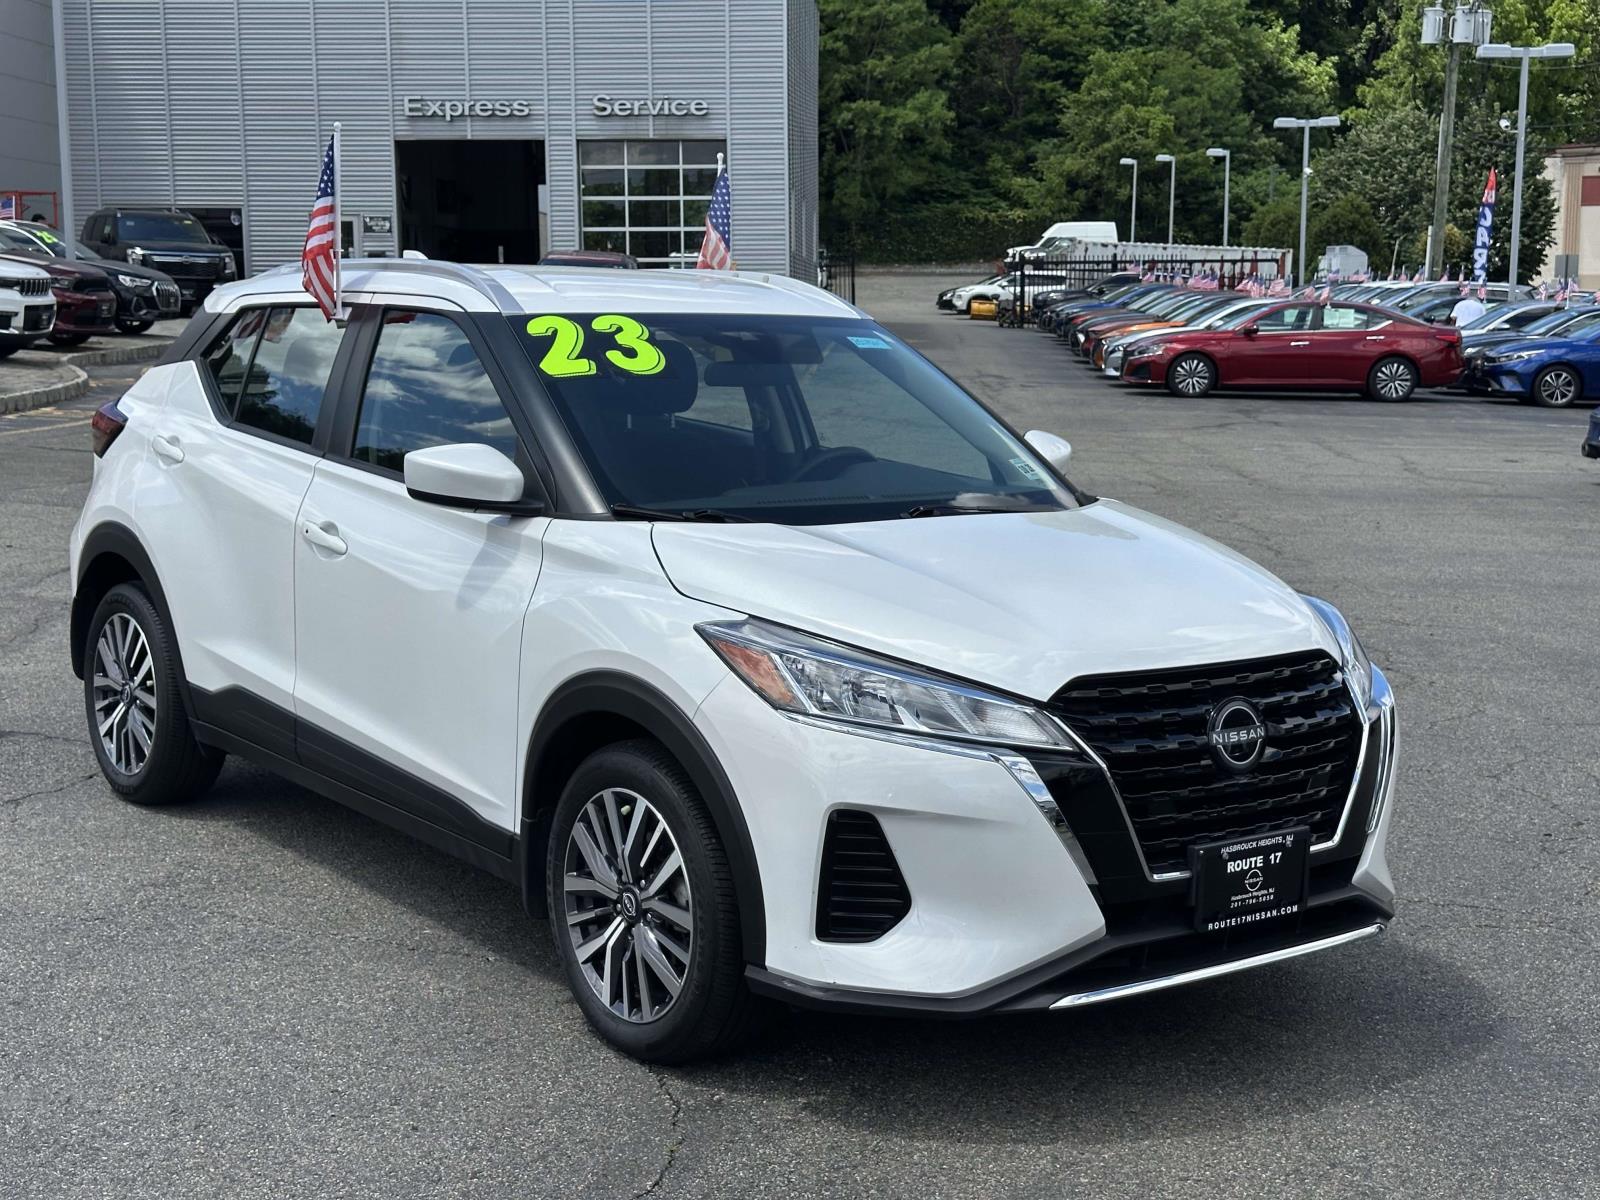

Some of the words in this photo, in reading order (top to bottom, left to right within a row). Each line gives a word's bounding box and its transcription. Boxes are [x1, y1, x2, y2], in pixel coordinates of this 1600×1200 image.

[404, 95, 531, 121] Express
[592, 94, 709, 117] Service
[526, 314, 666, 377] 23
[1212, 726, 1264, 744] NISSAN
[1220, 841, 1257, 854] HASBROUCK
[1285, 834, 1294, 842] NJ
[1227, 855, 1264, 873] ROUTE
[1269, 852, 1282, 864] 17
[1208, 904, 1298, 931] ROUTE17NISSAN.COM
